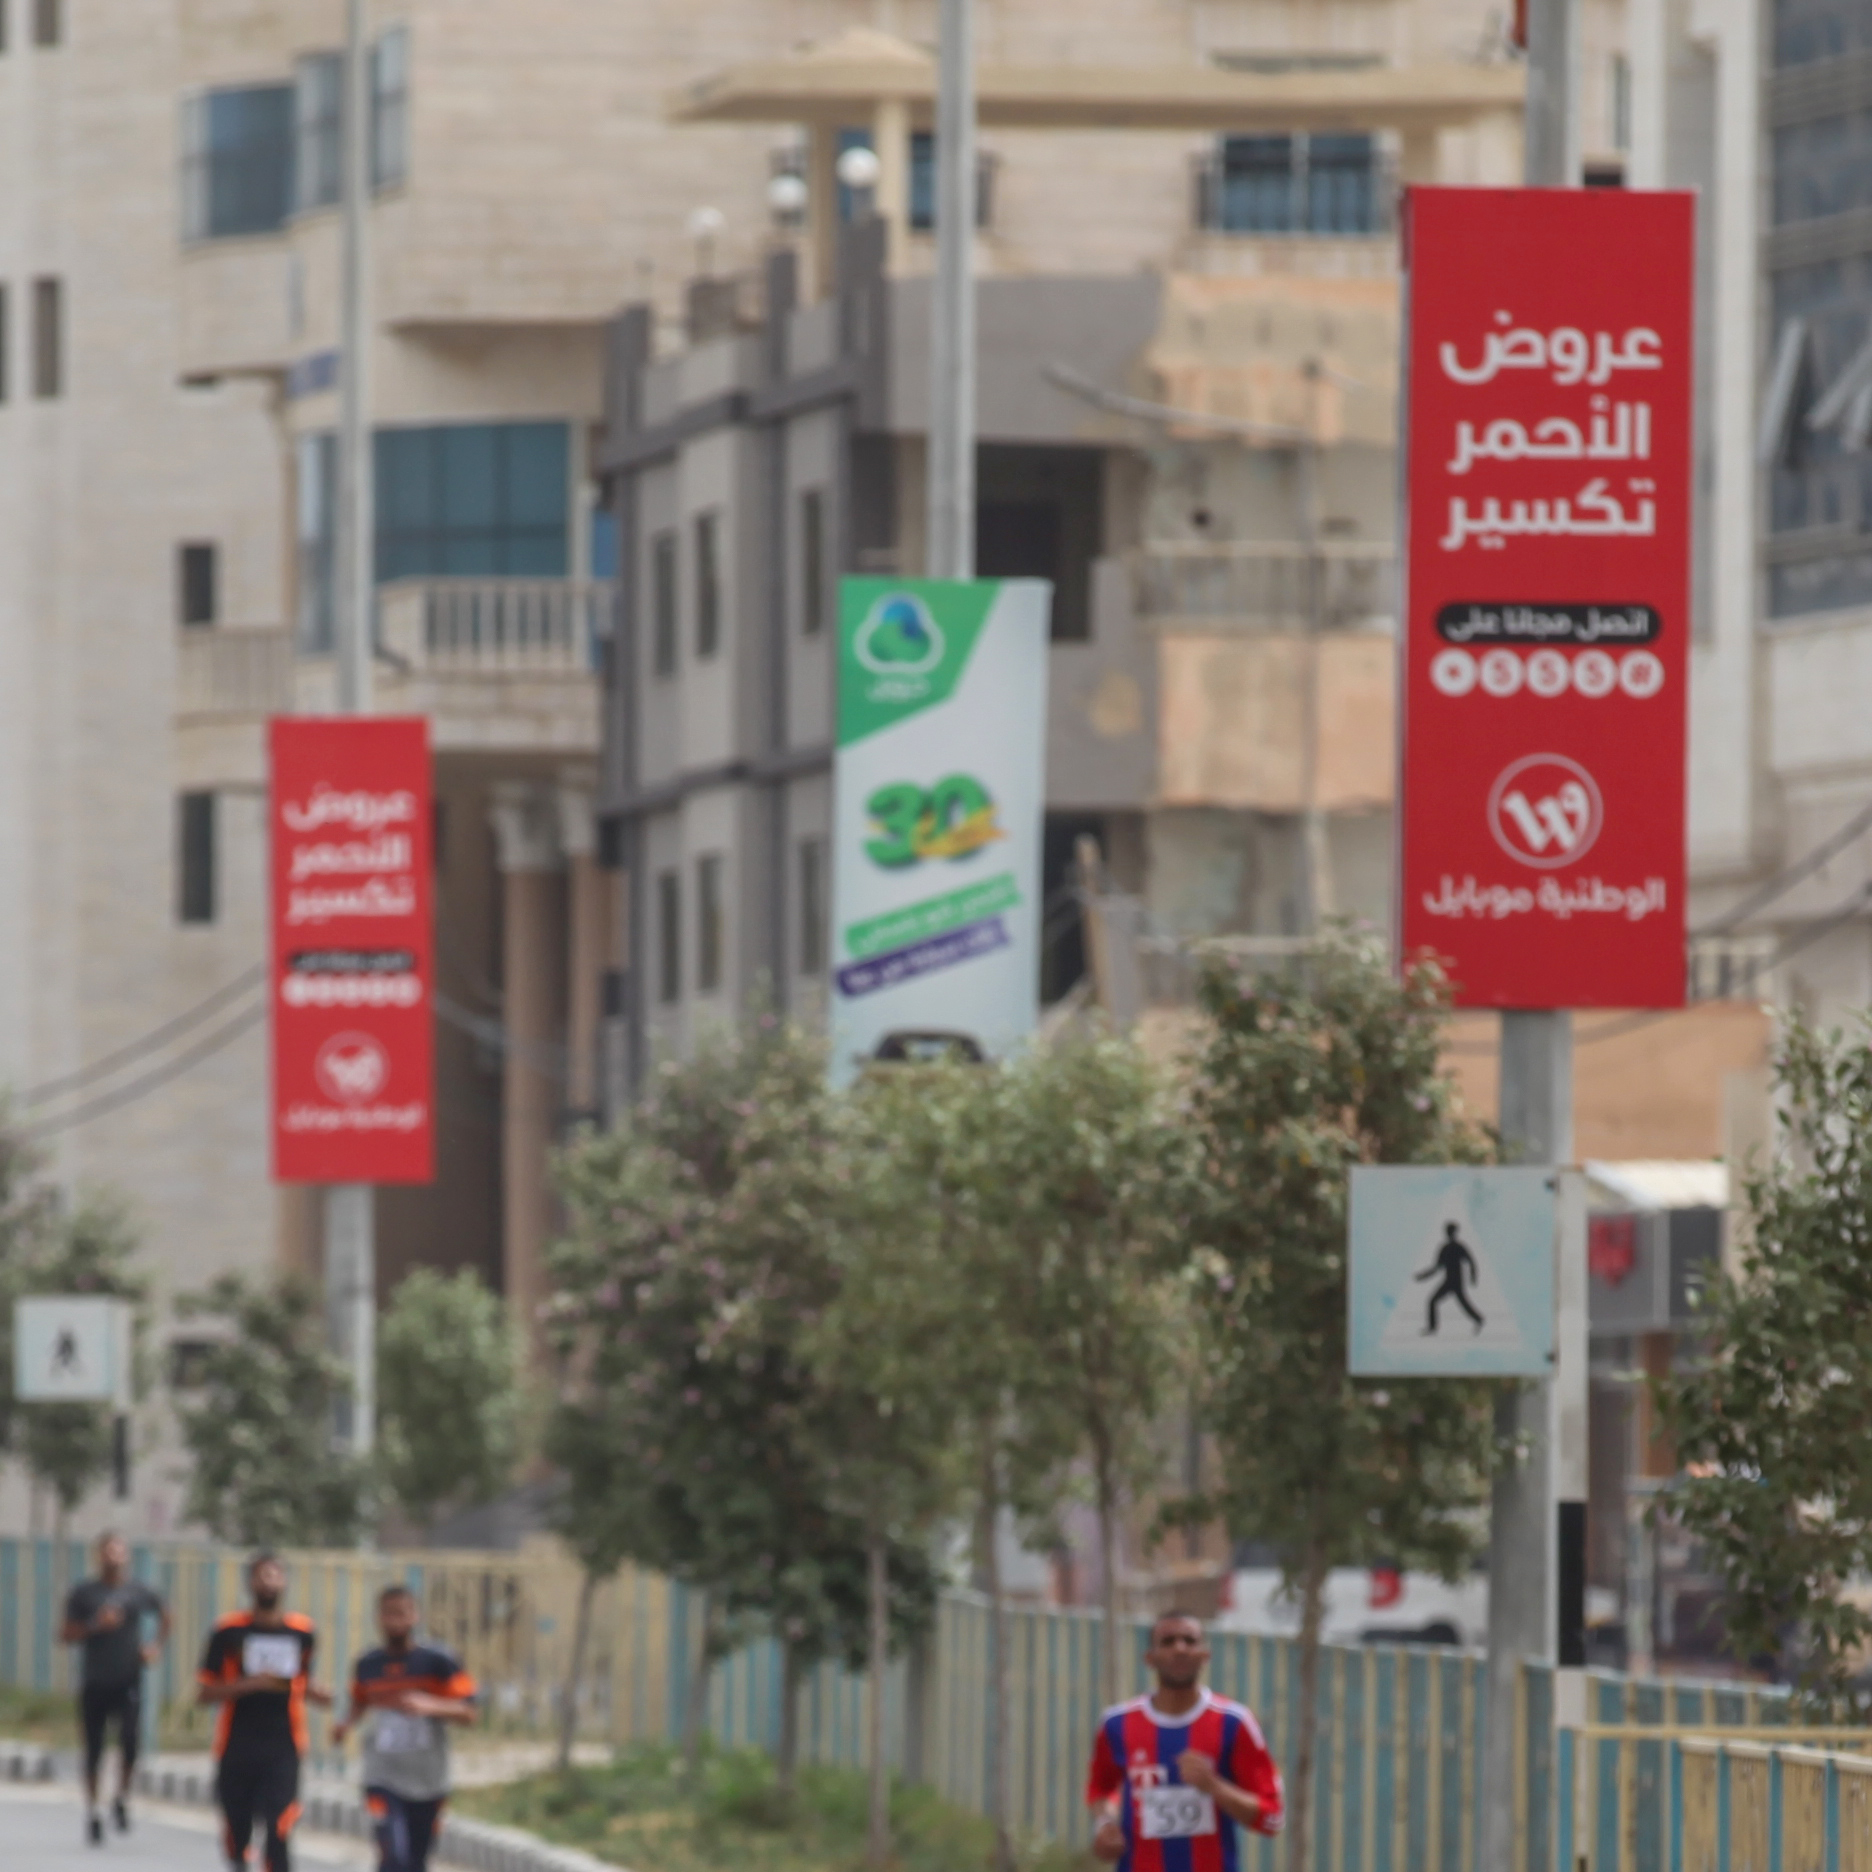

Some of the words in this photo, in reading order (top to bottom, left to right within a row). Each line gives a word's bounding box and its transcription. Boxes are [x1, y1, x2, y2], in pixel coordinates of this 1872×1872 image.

[1439, 310, 1662, 385] عروض
[1447, 394, 1651, 474] الأحمر
[1439, 477, 1656, 551] تكسير
[1574, 606, 1650, 642] اتصل
[864, 772, 991, 870] 30
[1536, 875, 1666, 922] الوطنية
[1154, 1799, 1203, 1835] 59
